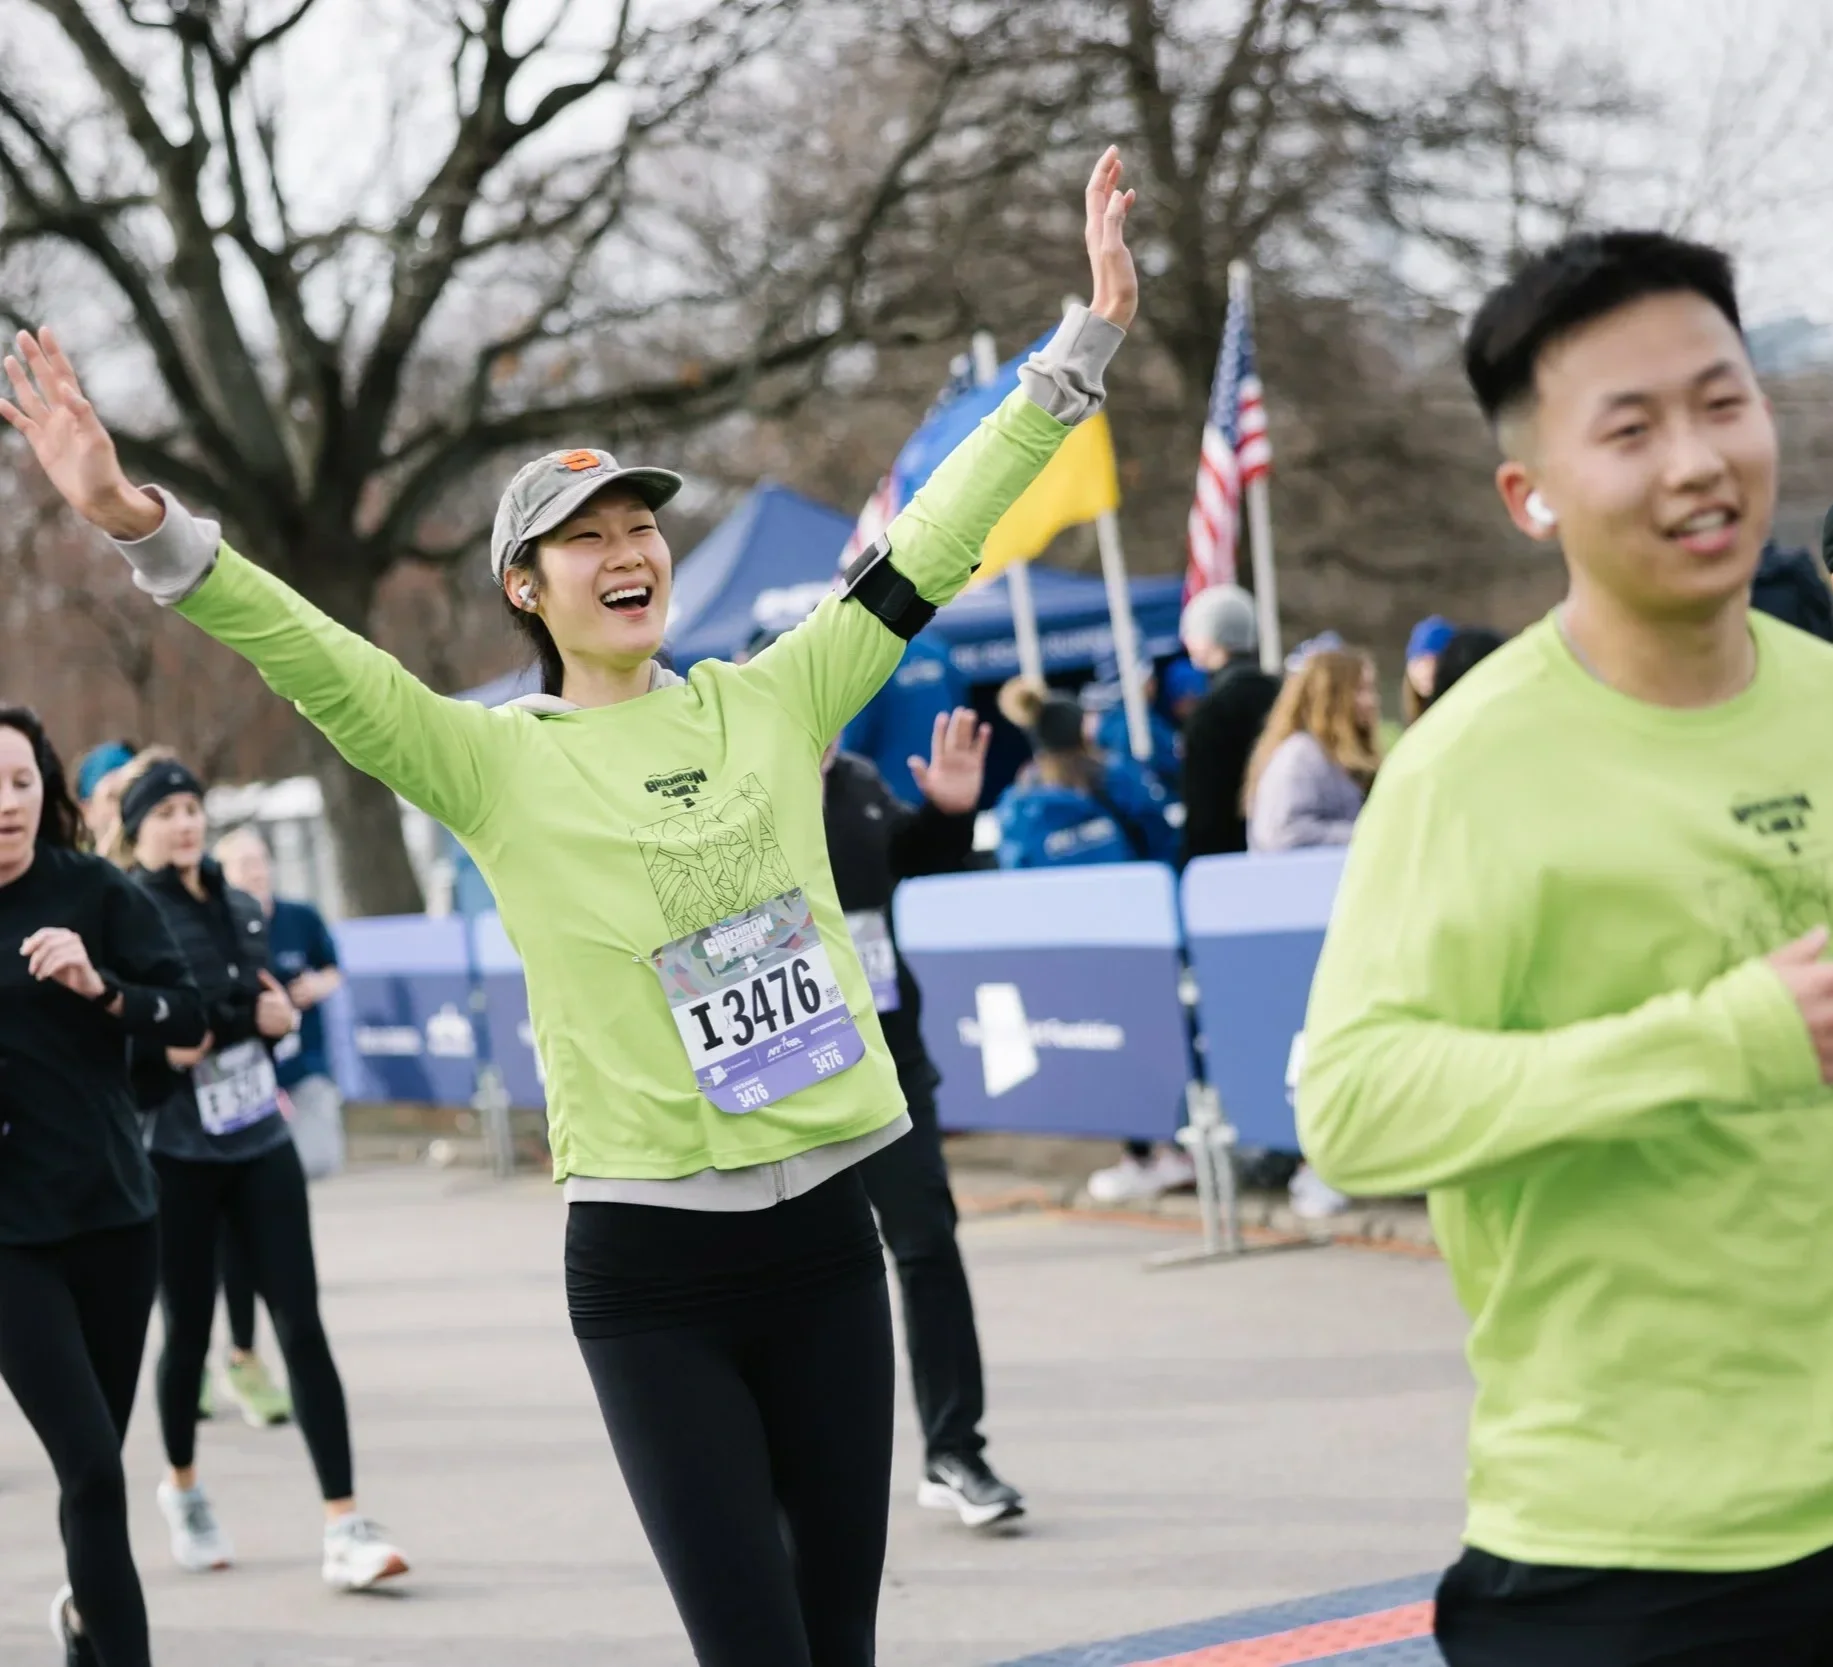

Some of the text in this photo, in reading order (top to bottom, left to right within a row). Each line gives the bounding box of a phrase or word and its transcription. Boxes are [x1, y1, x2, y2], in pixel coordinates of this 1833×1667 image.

[644, 768, 708, 793] GRIDIRON
[661, 784, 700, 798] 4-MILE
[703, 913, 774, 957] GRIDIRON
[689, 1002, 724, 1051] I
[722, 958, 821, 1046] 3476
[812, 1048, 844, 1074] 3476
[736, 1082, 770, 1108] 3476
